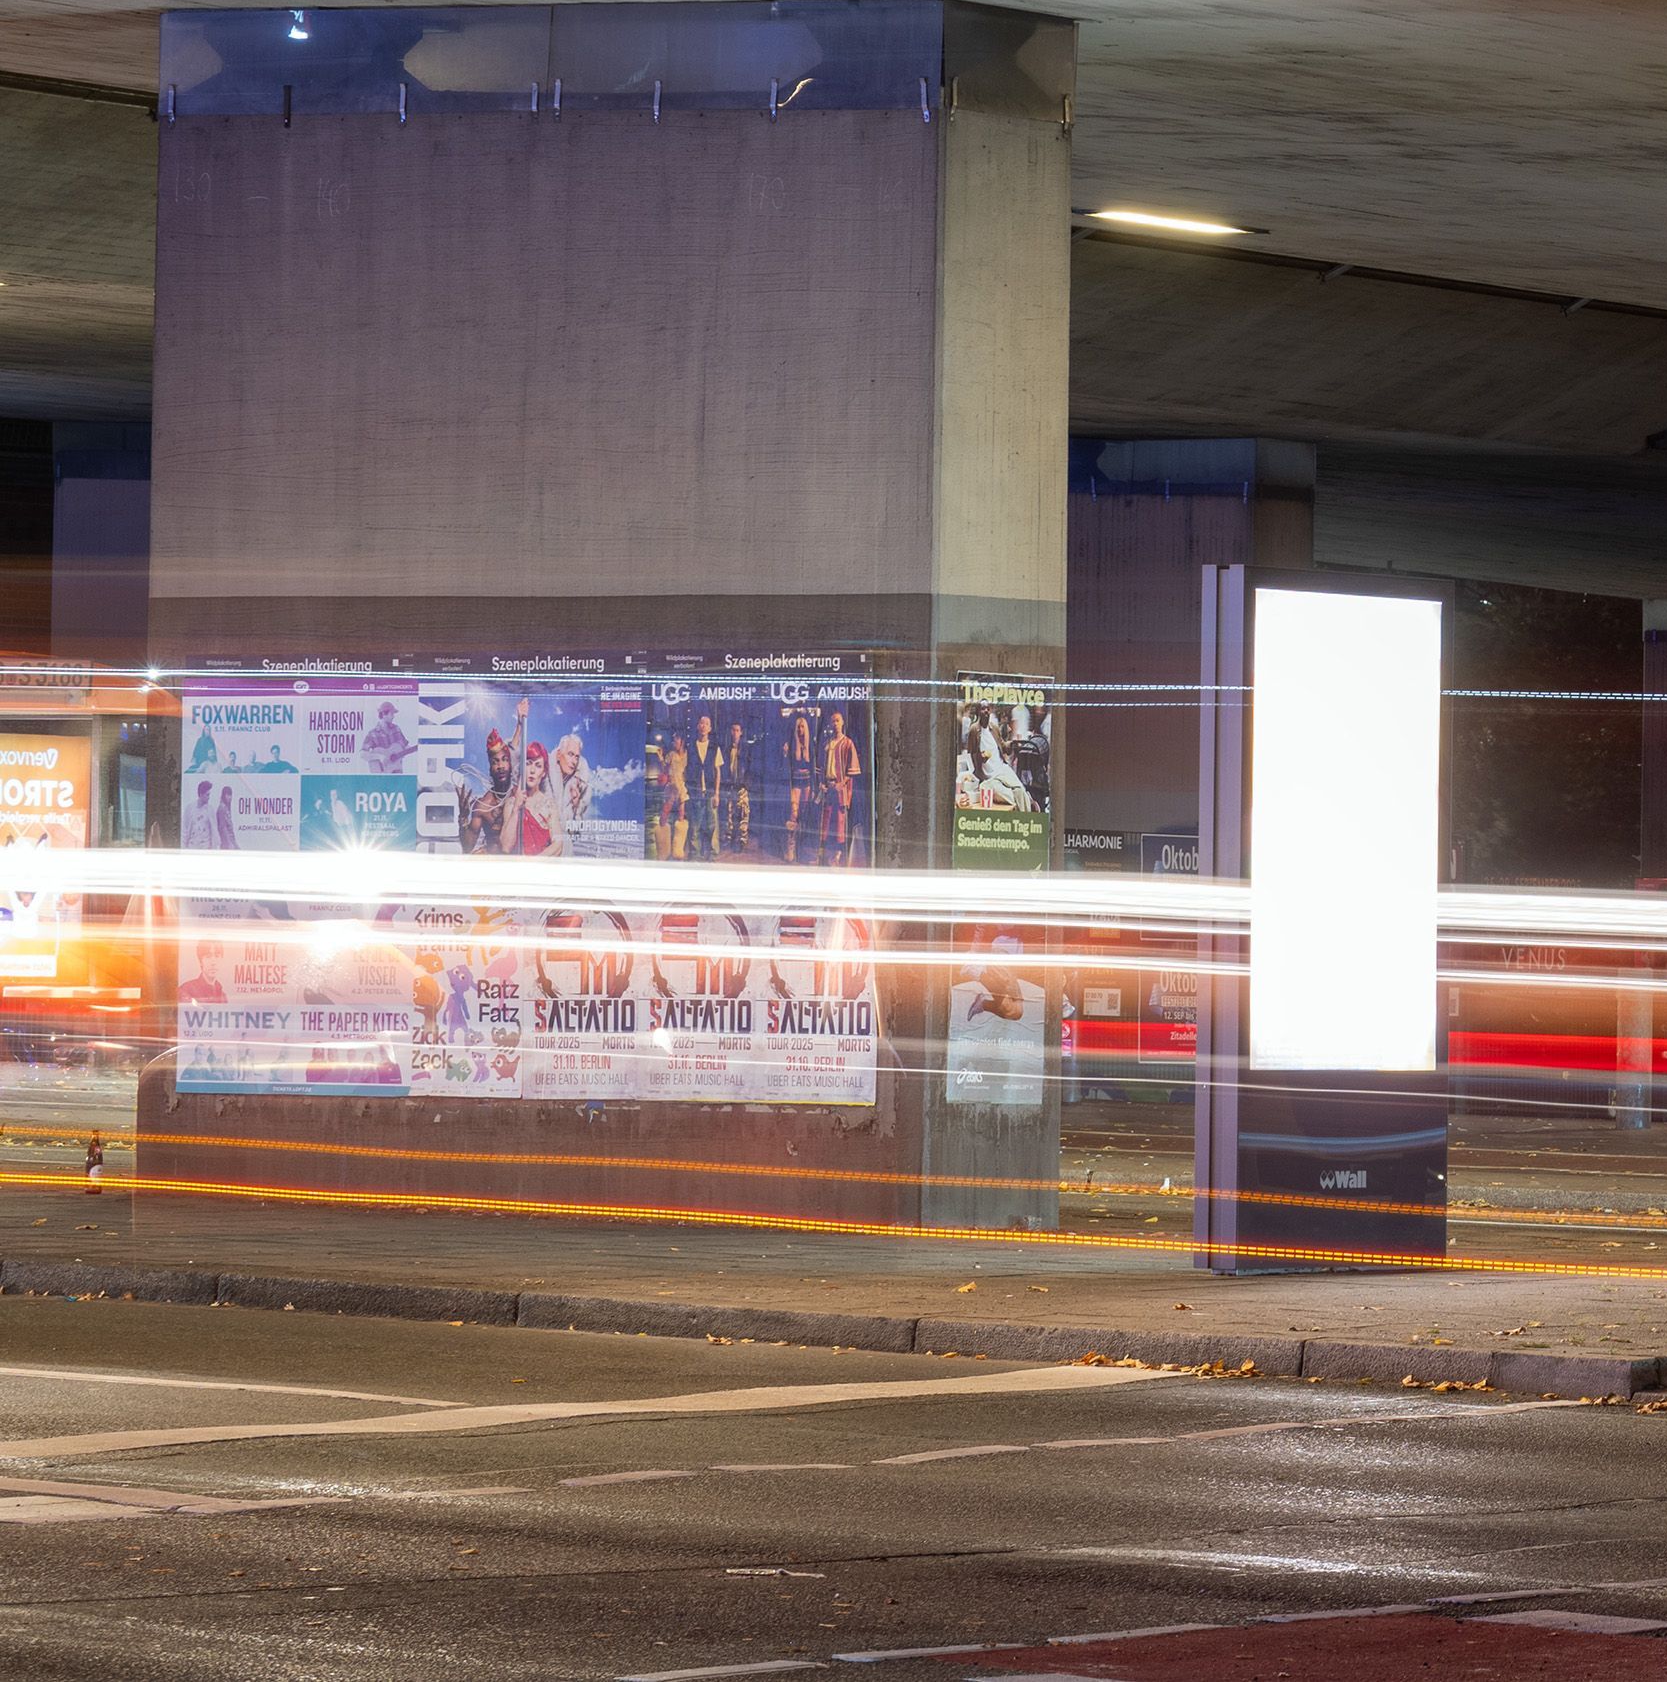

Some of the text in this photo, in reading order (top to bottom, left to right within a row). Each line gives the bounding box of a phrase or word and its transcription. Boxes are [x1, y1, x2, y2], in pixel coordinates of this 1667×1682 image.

[491, 656, 605, 673] Szeneplakatierung
[725, 654, 841, 671] Szeneplakatierung
[651, 682, 691, 705] UGG
[770, 682, 810, 705] UGG
[191, 704, 294, 725] FOXWARREN
[309, 710, 364, 731] HARRISON
[317, 734, 355, 754] STORM
[238, 797, 293, 816] OH WONDER
[355, 791, 408, 813] ROYA
[958, 817, 1043, 837] Genieß den Tag im
[957, 834, 1030, 853] Snackentempo.
[1501, 947, 1567, 970] VENUS
[234, 965, 287, 985] MALTESE
[477, 979, 519, 999] Ratz
[184, 1010, 292, 1030] WHITNEY
[300, 1011, 409, 1033] THE PAPER KITES
[478, 1003, 520, 1023] Fatz
[534, 999, 636, 1033] SALTATIO
[649, 999, 752, 1034] SALTATIO
[767, 1000, 872, 1036] SALTATIO
[602, 1036, 636, 1050] MORTIS
[718, 1037, 752, 1050] MORTIS
[837, 1039, 871, 1052] MORTIS
[411, 1049, 453, 1070] Zack
[580, 1054, 611, 1070] BERLIN
[695, 1054, 727, 1071] BERLIN
[814, 1056, 846, 1072] BERLIN
[558, 1073, 578, 1086] EATS
[608, 1073, 629, 1086] HALL
[673, 1073, 692, 1086] EATS
[767, 1074, 864, 1088] UBER EATS MUSIC HALL
[1334, 1170, 1367, 1189] Wall
